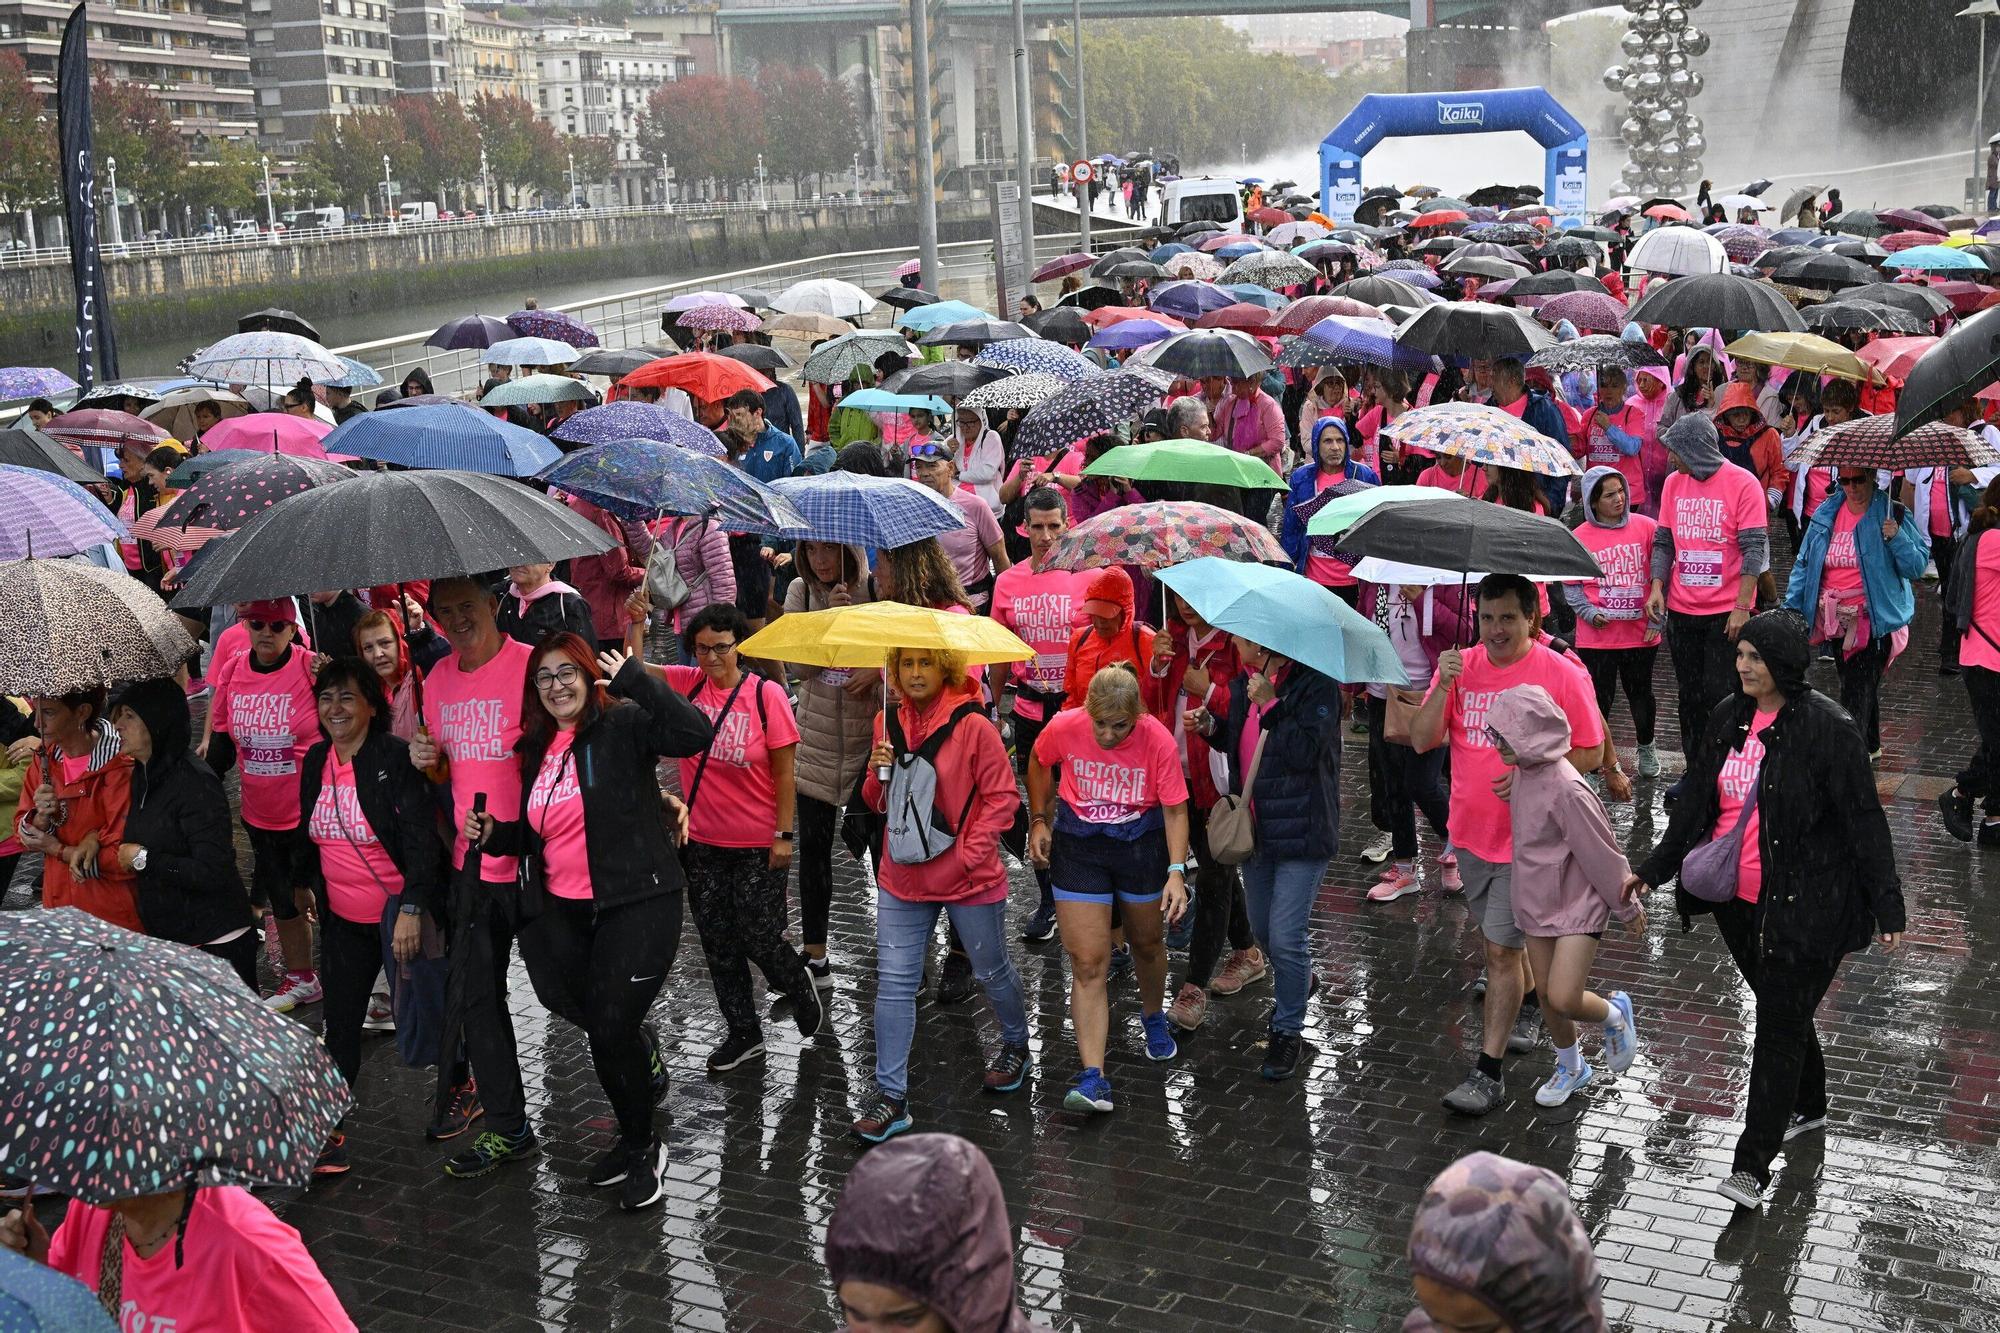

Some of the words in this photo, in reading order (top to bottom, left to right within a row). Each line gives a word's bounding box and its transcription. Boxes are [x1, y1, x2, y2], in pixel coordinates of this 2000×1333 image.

[1443, 106, 1479, 122] Kaiku
[1594, 445, 1613, 453] 2025
[1677, 523, 1723, 541] AVANZA
[1684, 562, 1712, 574] 2025
[1606, 598, 1635, 609] 2025
[1021, 625, 1070, 643] AVANZA
[1033, 668, 1065, 680] 2025
[250, 749, 283, 762] 2025
